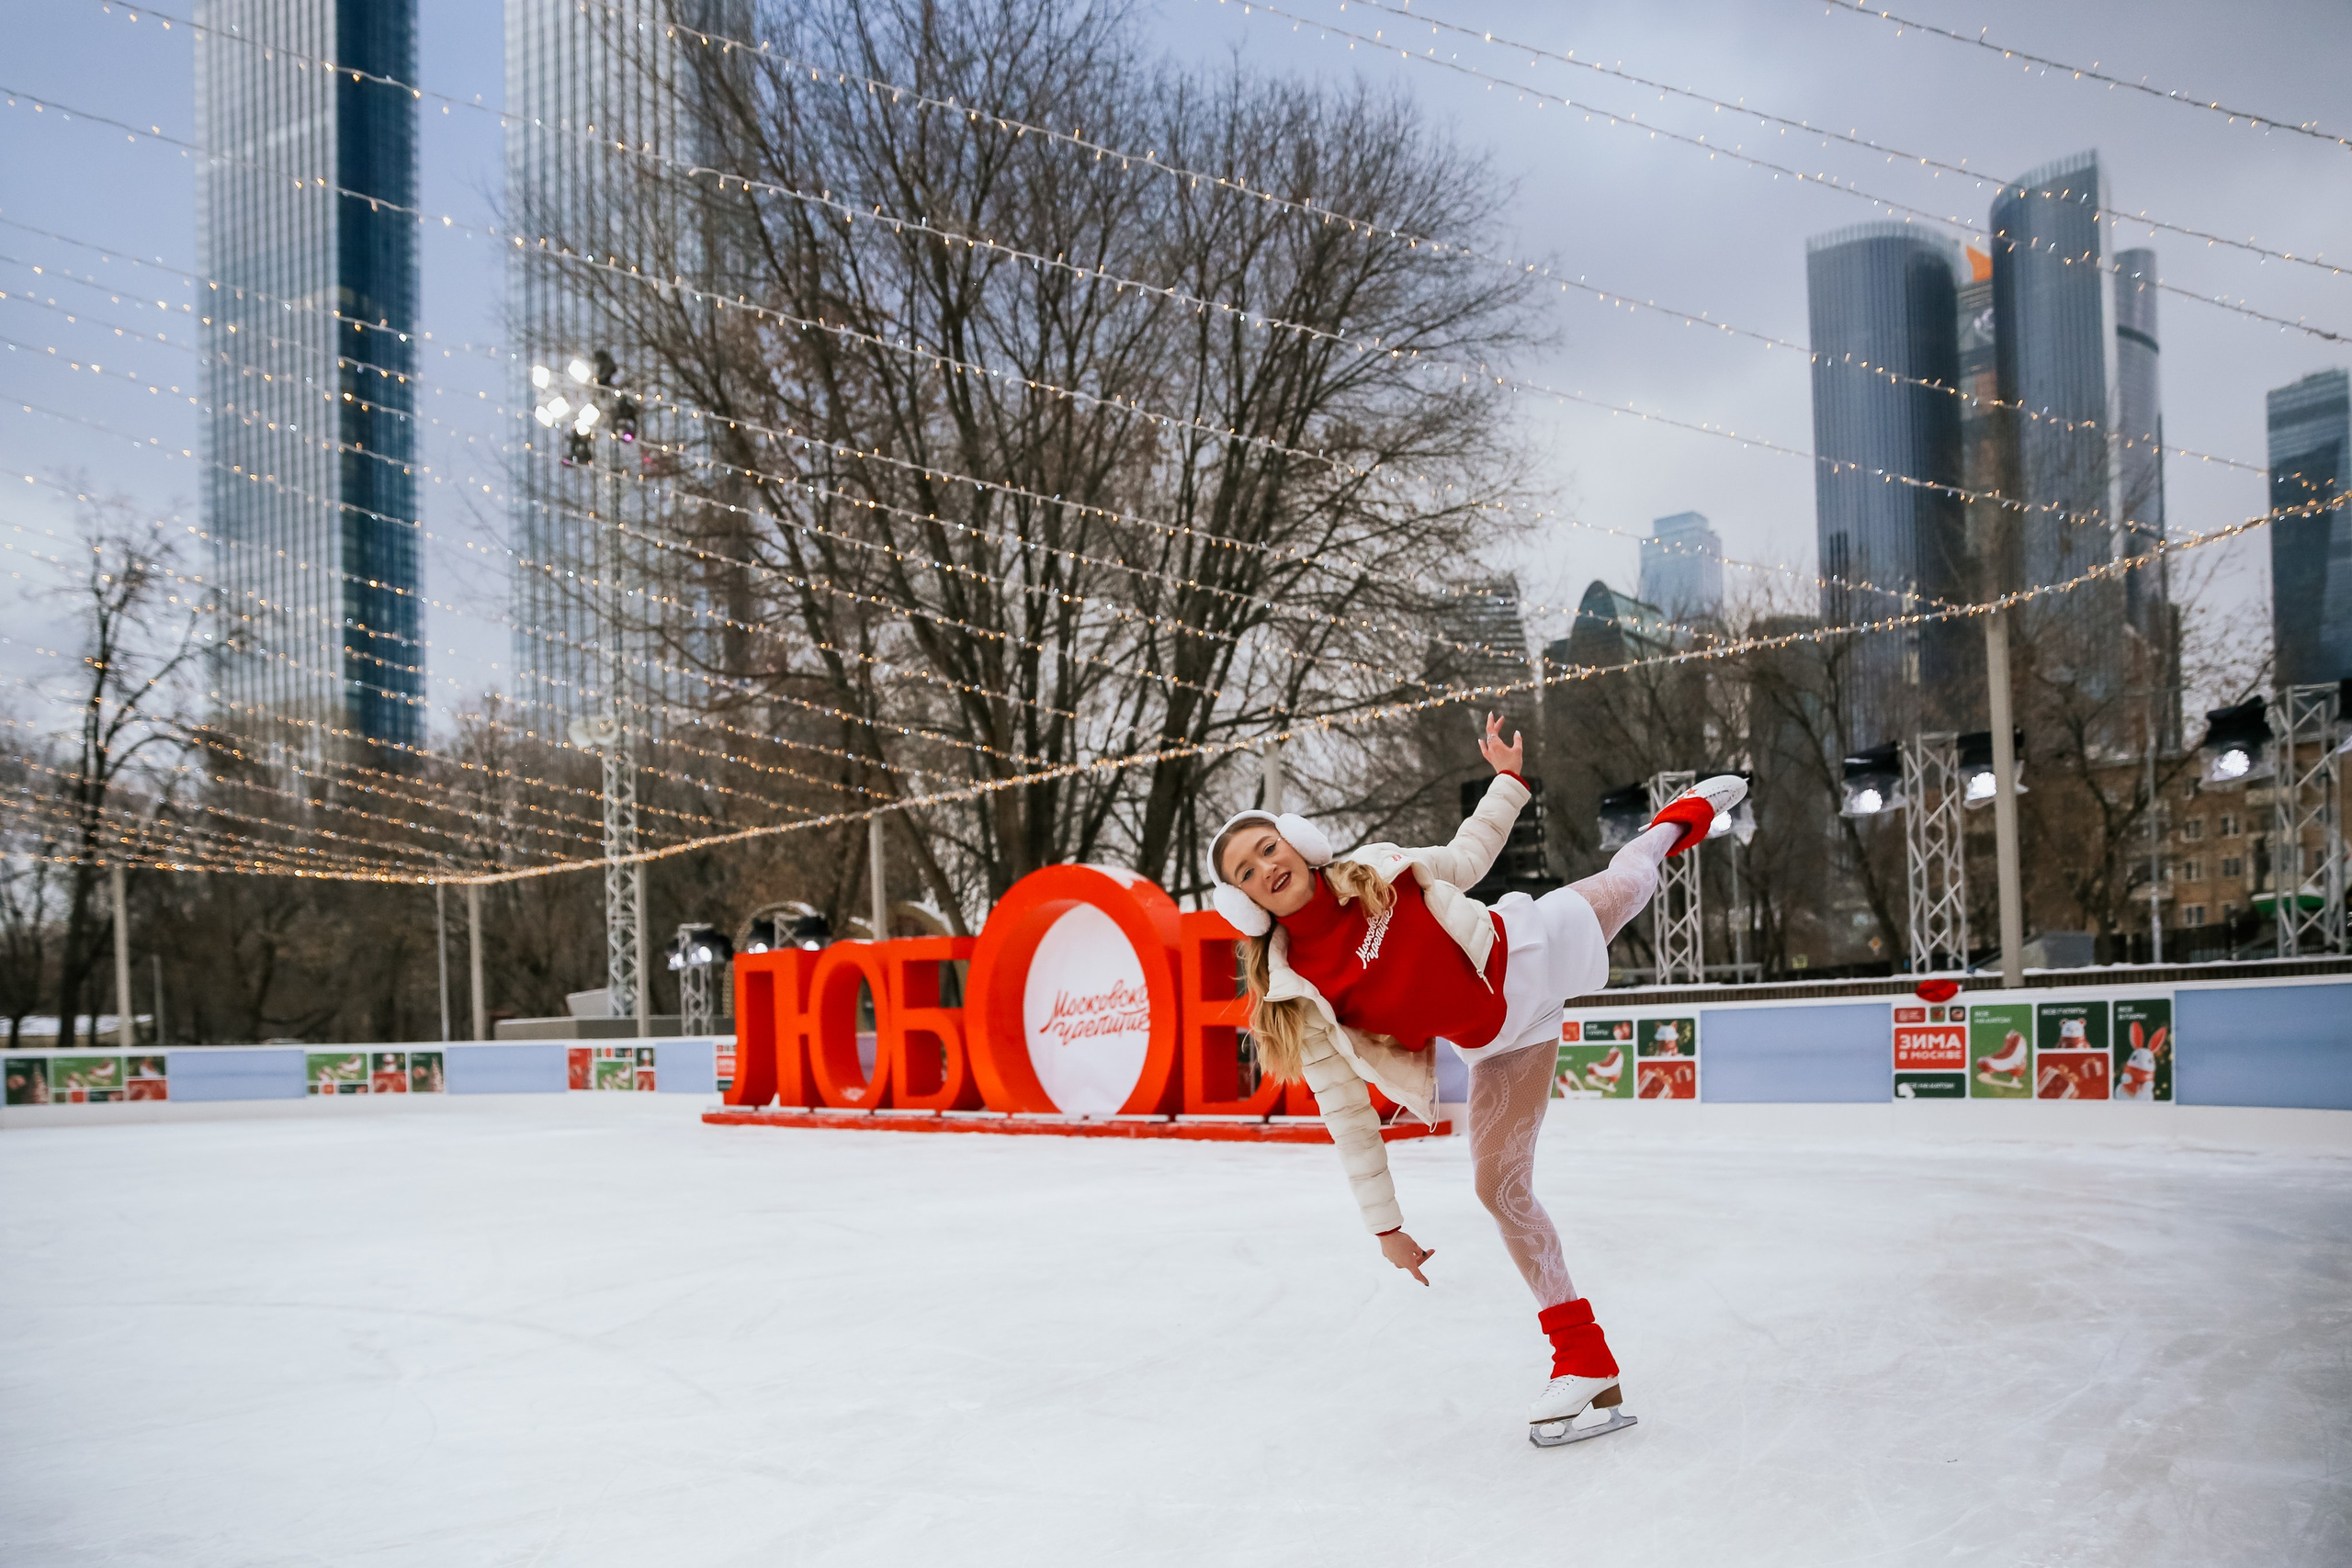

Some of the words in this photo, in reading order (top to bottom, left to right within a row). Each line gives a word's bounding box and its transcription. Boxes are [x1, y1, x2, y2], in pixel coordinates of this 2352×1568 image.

[1355, 915, 1379, 969] Московс
[723, 863, 1408, 1119] ЛЮБОВ
[1899, 1033, 1962, 1049] ЗИМА
[1899, 1051, 1907, 1060] В
[1911, 1050, 1962, 1060] МОСКВЕ
